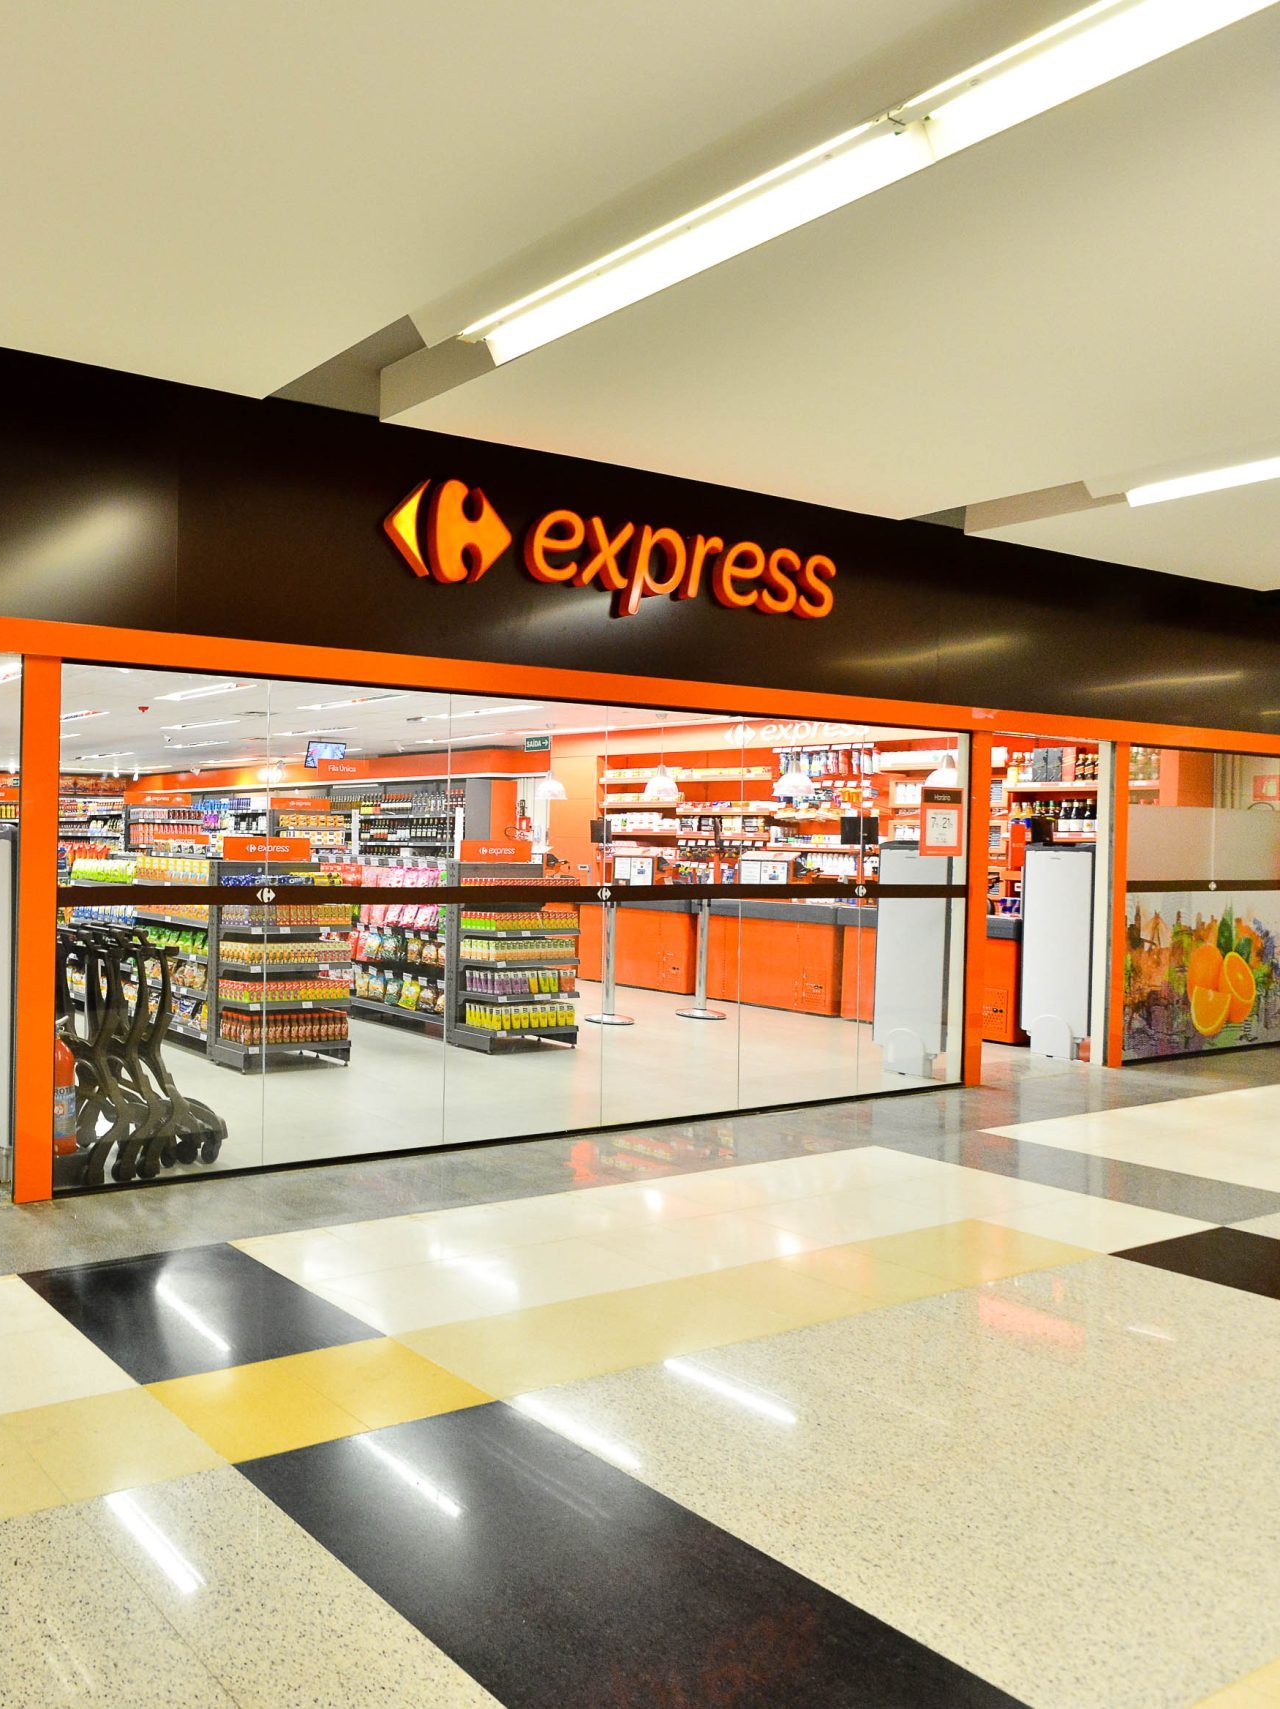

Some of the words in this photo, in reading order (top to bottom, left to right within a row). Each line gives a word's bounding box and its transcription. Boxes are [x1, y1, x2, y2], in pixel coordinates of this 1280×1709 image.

[524, 509, 837, 619] express
[328, 764, 339, 772] Fila
[257, 844, 290, 853] express
[488, 847, 516, 856] express
